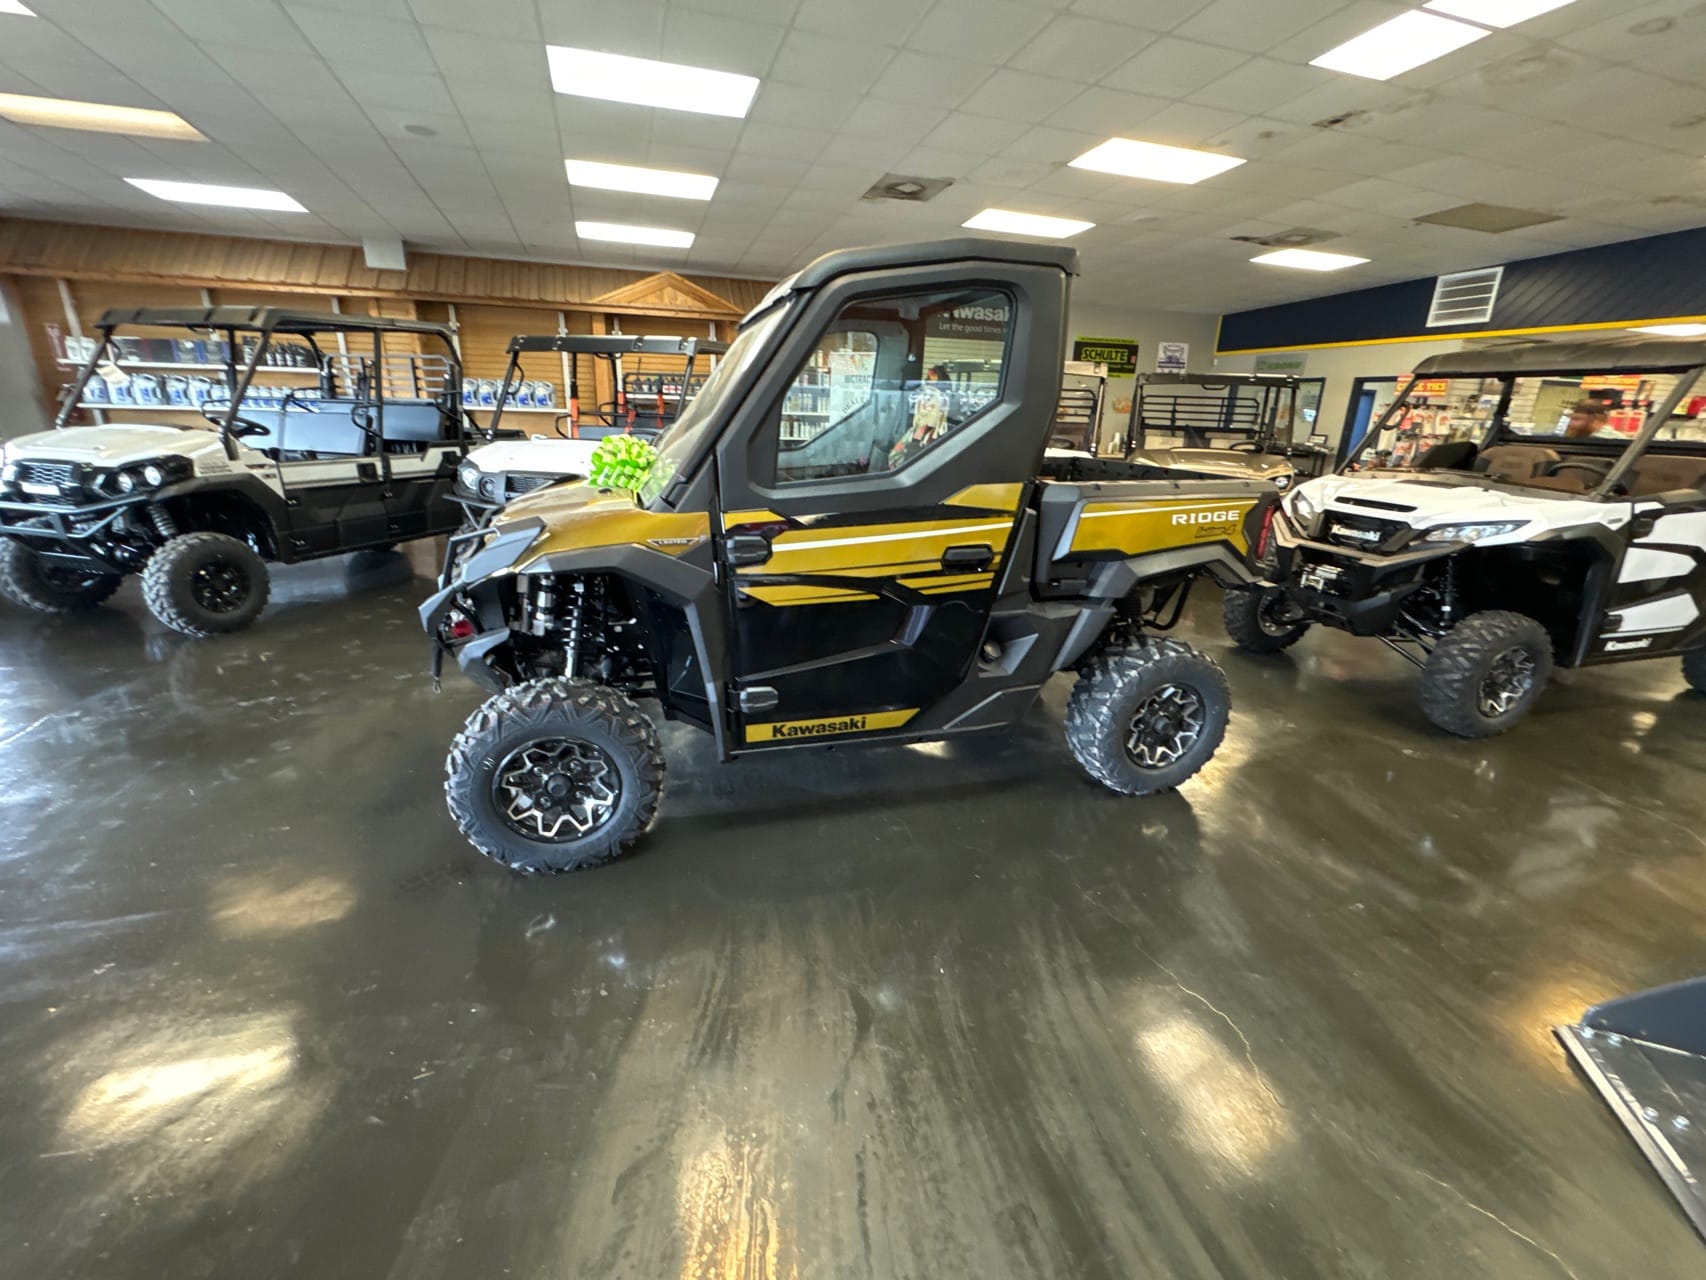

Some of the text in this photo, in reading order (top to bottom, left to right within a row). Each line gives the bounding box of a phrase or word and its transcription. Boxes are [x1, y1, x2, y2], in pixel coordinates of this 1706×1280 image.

[937, 305, 1010, 322] wasa
[938, 321, 950, 331] Let
[952, 322, 963, 332] the
[965, 324, 983, 333] good
[1082, 347, 1127, 362] SCHULTE
[1171, 510, 1241, 526] RIDGE
[772, 716, 867, 738] Kawasaki
